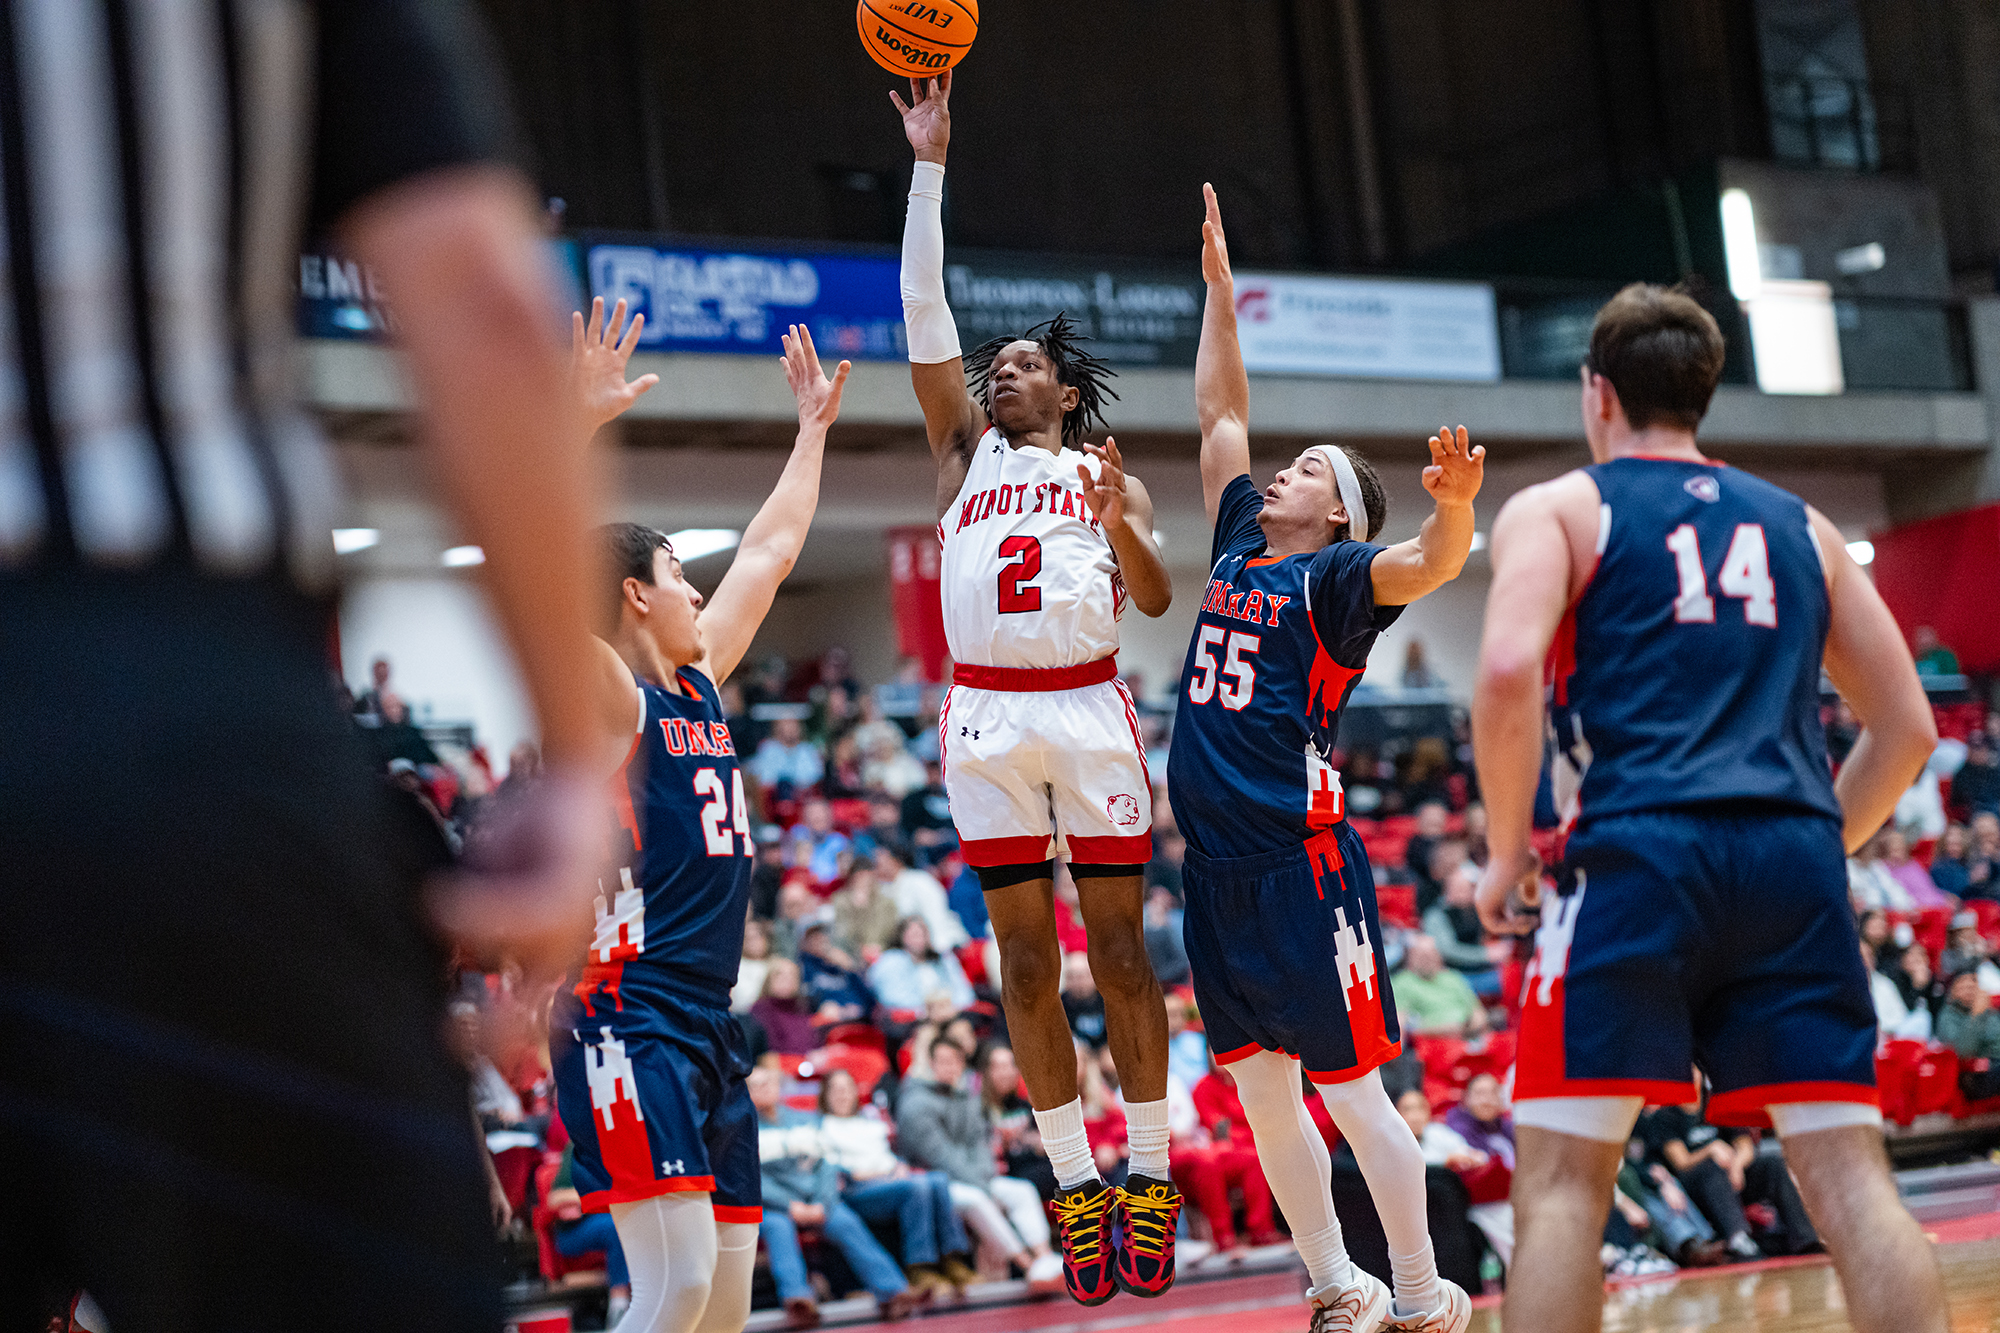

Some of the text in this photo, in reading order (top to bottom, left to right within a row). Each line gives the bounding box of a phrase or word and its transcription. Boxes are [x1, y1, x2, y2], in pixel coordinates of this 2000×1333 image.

[876, 25, 951, 68] Wilson
[903, 2, 953, 28] EVO
[956, 482, 1028, 535] MINOT
[998, 535, 1042, 614] 2
[1666, 523, 1778, 629] 14
[1188, 623, 1261, 712] 55
[693, 767, 755, 857] 24
